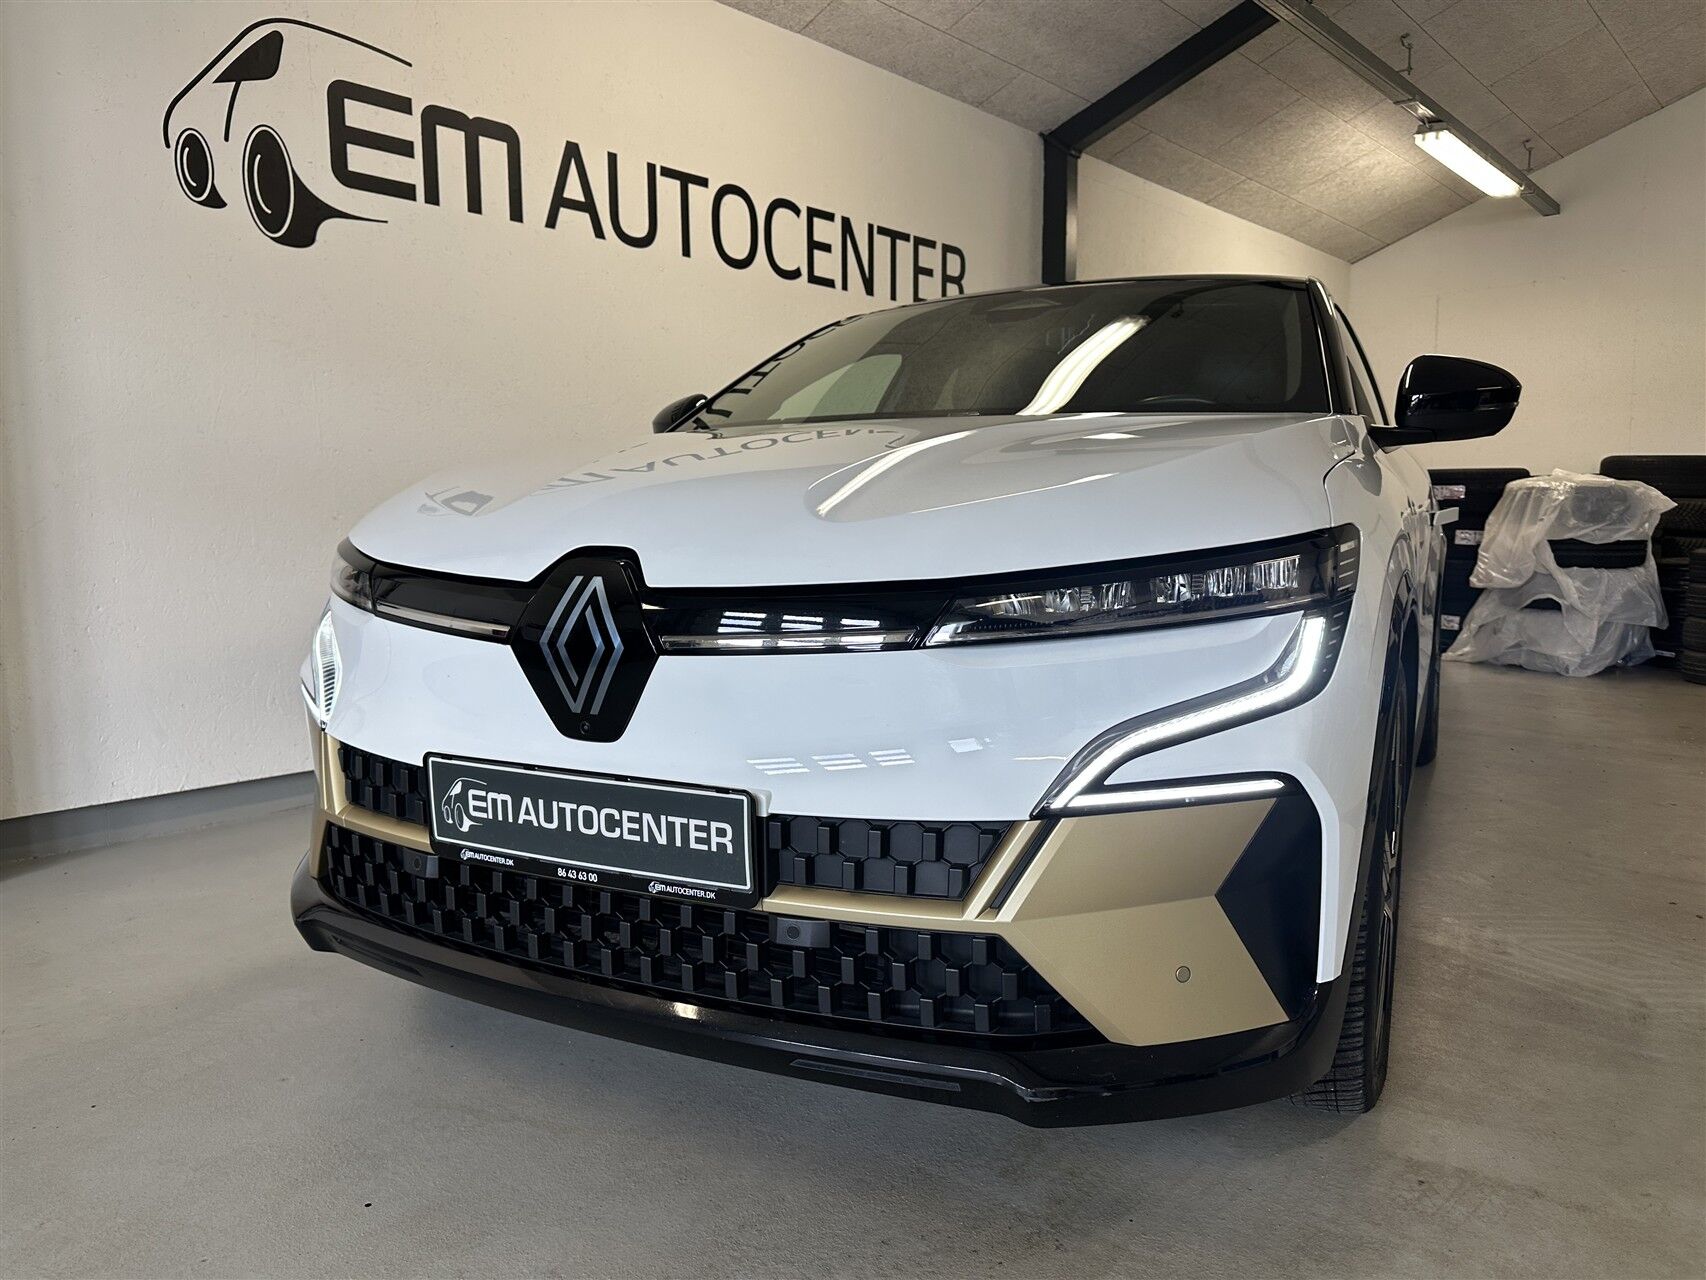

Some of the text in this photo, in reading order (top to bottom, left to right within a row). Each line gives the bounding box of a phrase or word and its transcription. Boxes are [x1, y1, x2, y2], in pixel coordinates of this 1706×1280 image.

[544, 140, 966, 303] AUTOCENTER
[517, 796, 733, 854] AUTOCENTER
[474, 853, 515, 866] AUTOCENTER.DK
[557, 867, 598, 882] 86 43 63 00
[666, 885, 716, 899] AUTOCENTER.DK
